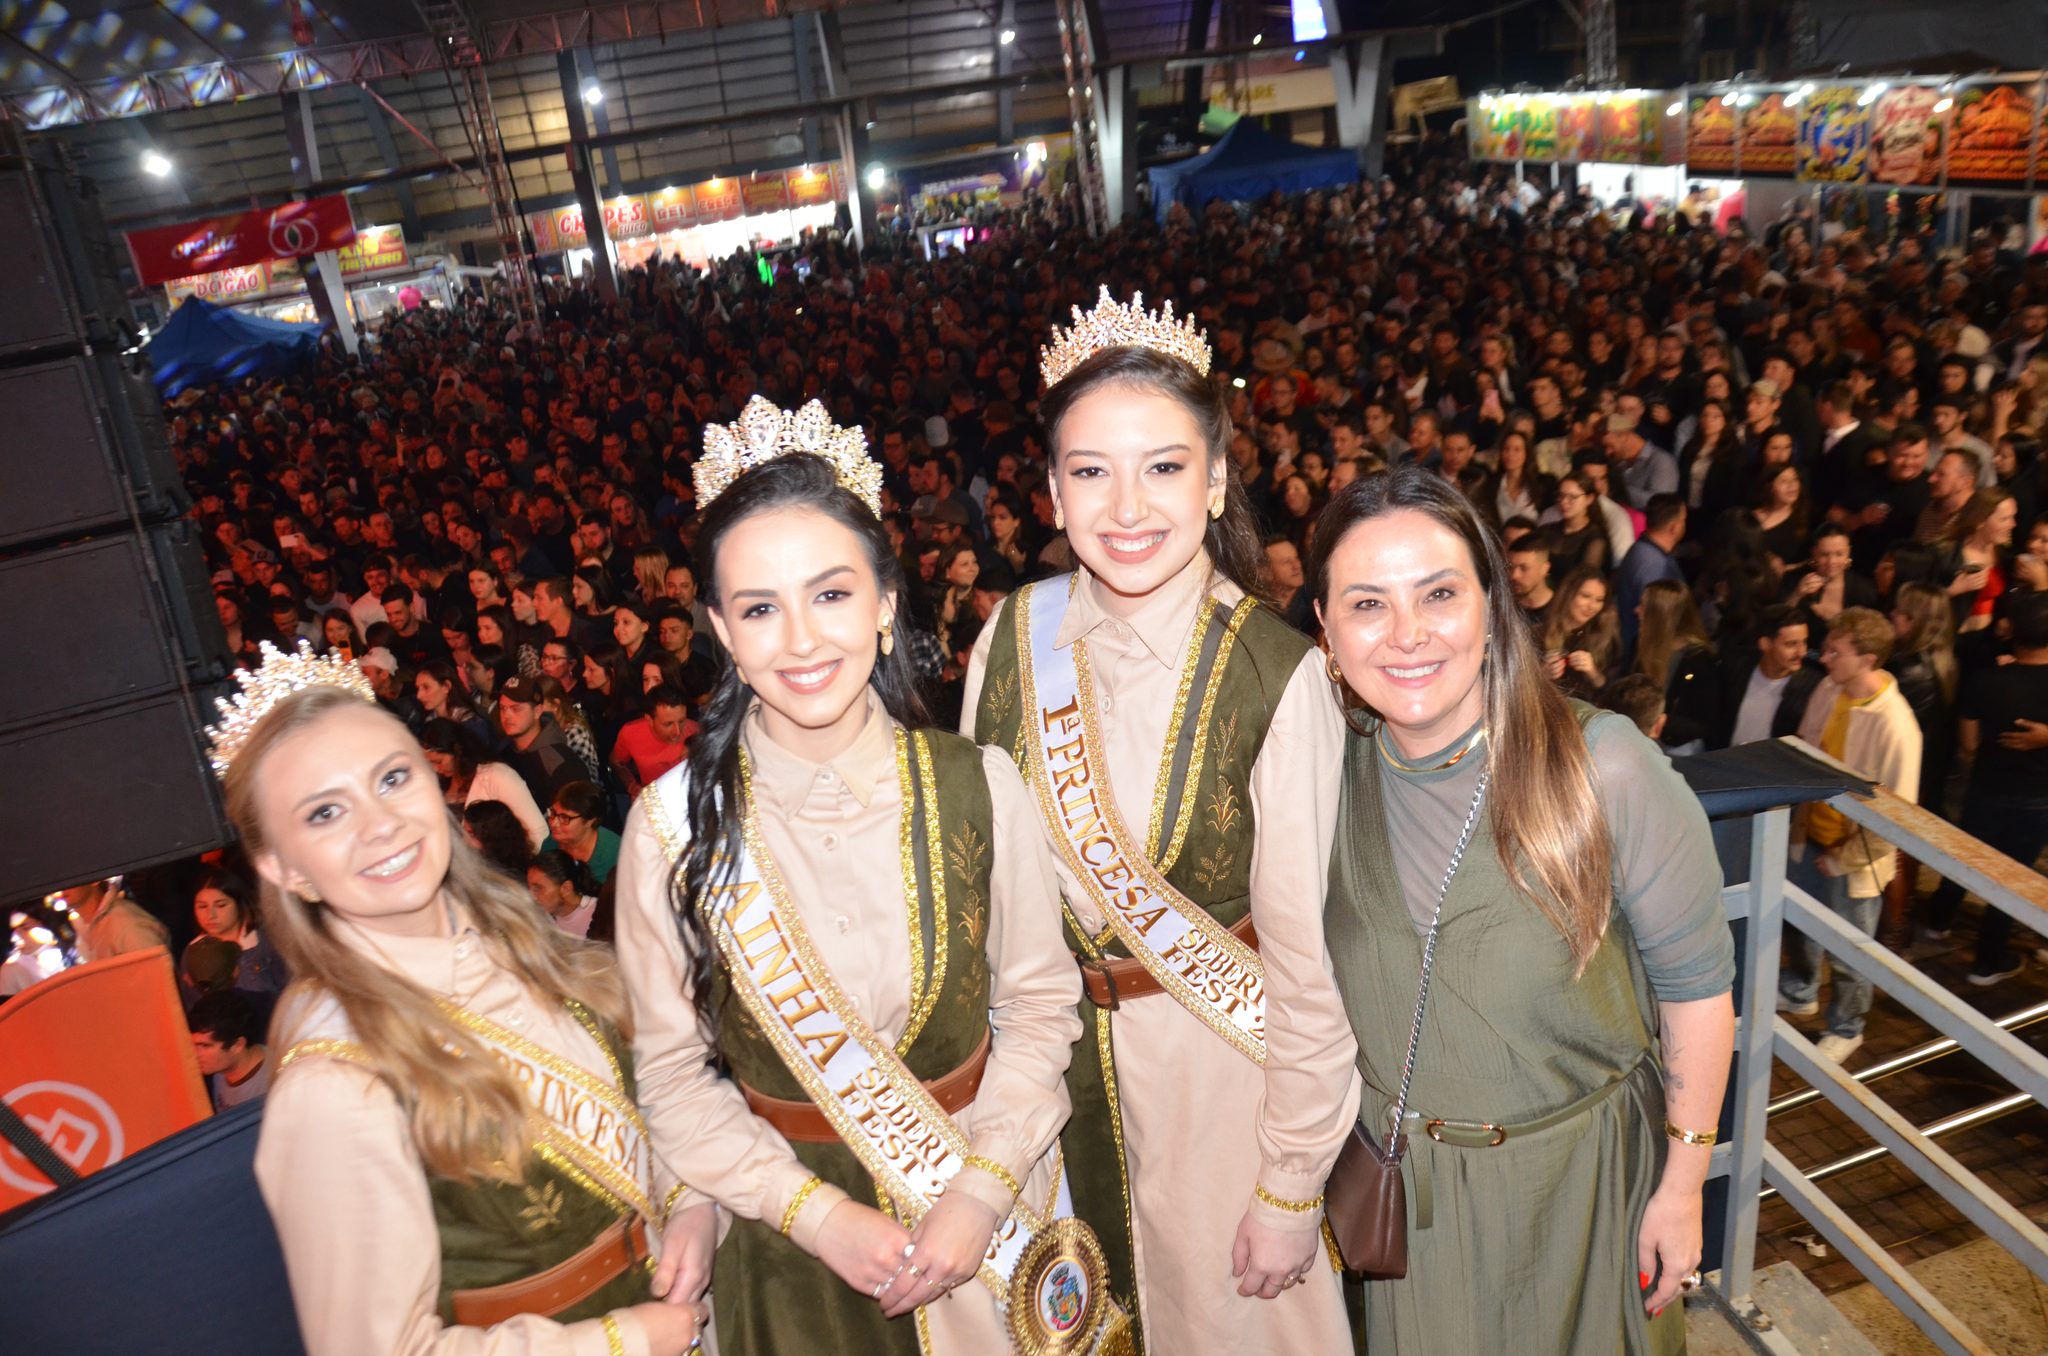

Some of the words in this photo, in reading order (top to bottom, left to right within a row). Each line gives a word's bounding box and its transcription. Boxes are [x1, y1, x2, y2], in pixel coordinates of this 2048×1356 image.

[560, 200, 642, 235] CRPES
[1047, 734, 1169, 937] PRINCESA
[709, 834, 850, 1073] AINHA
[1160, 942, 1248, 1018] FEST
[1177, 928, 1264, 1009] SEBERI
[836, 1080, 926, 1178] FEST
[856, 1066, 950, 1172] SEBERI
